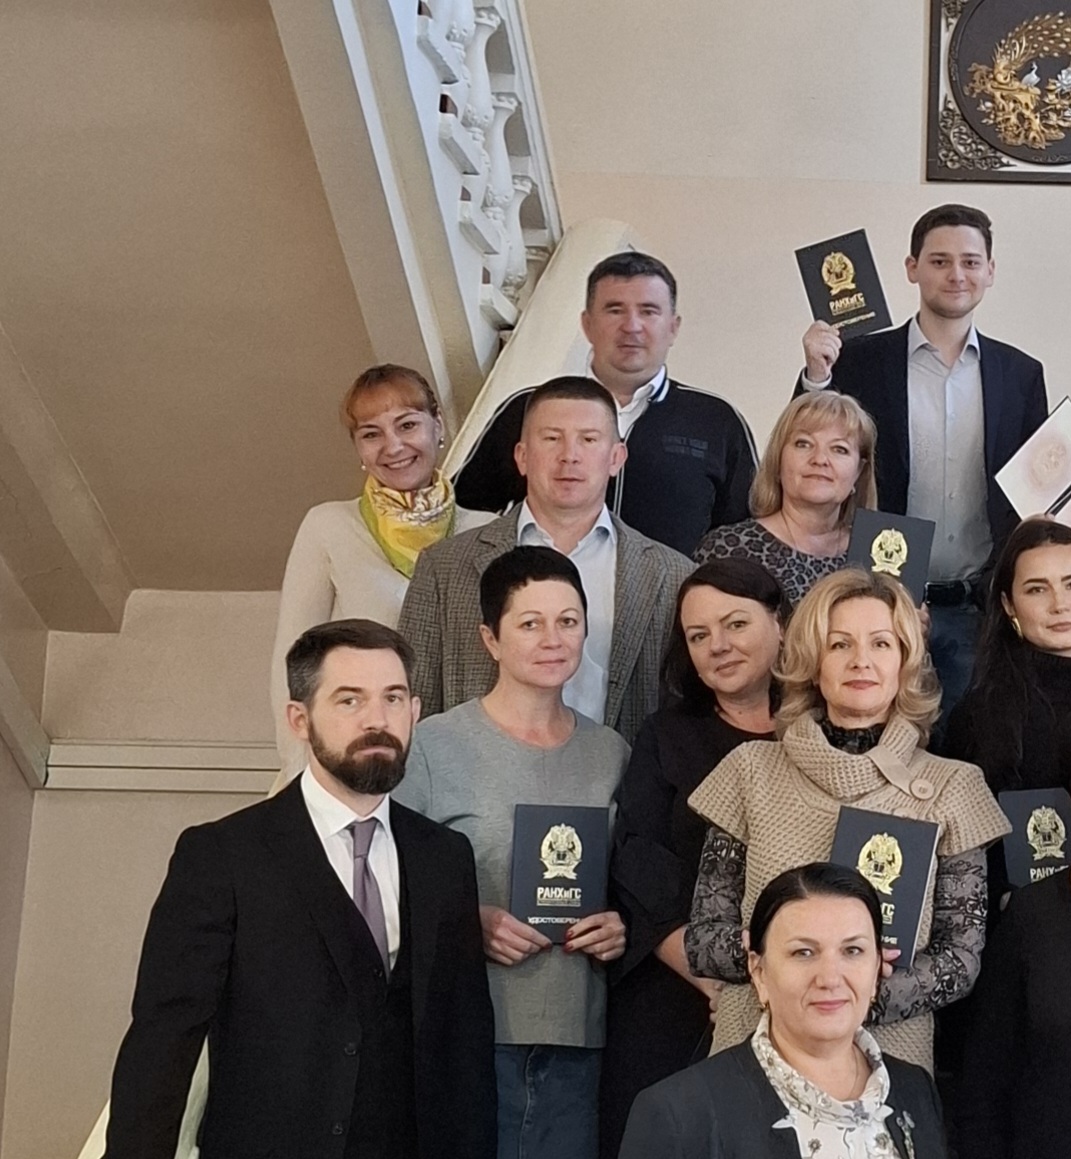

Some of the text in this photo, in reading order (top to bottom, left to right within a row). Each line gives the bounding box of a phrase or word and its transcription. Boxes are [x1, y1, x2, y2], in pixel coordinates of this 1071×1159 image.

[829, 293, 864, 310] РАНХиГС
[1030, 865, 1069, 881] РАНХ
[537, 887, 581, 899] РАНХиГС
